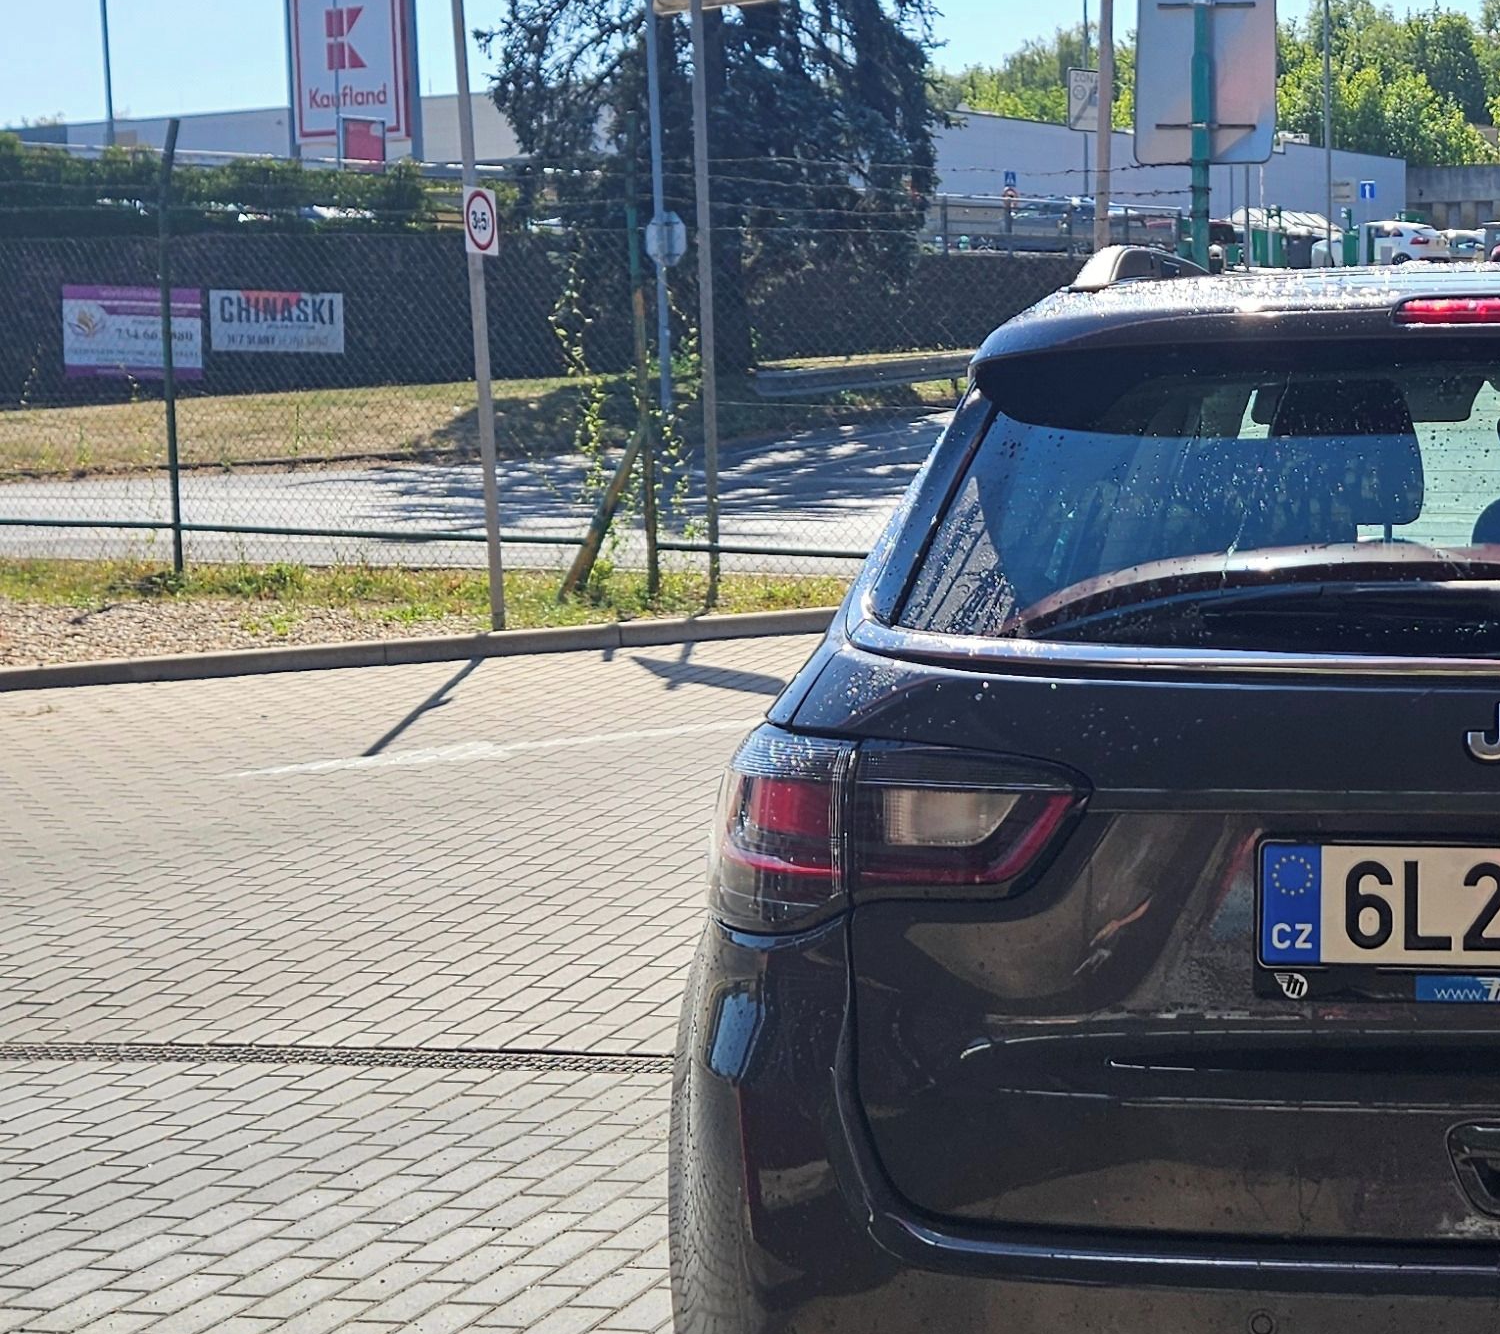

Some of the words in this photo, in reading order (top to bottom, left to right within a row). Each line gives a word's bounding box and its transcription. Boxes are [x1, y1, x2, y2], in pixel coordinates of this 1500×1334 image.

[309, 83, 387, 109] Kaufland
[221, 296, 334, 325] CHINASKI
[1272, 924, 1312, 950] CZ
